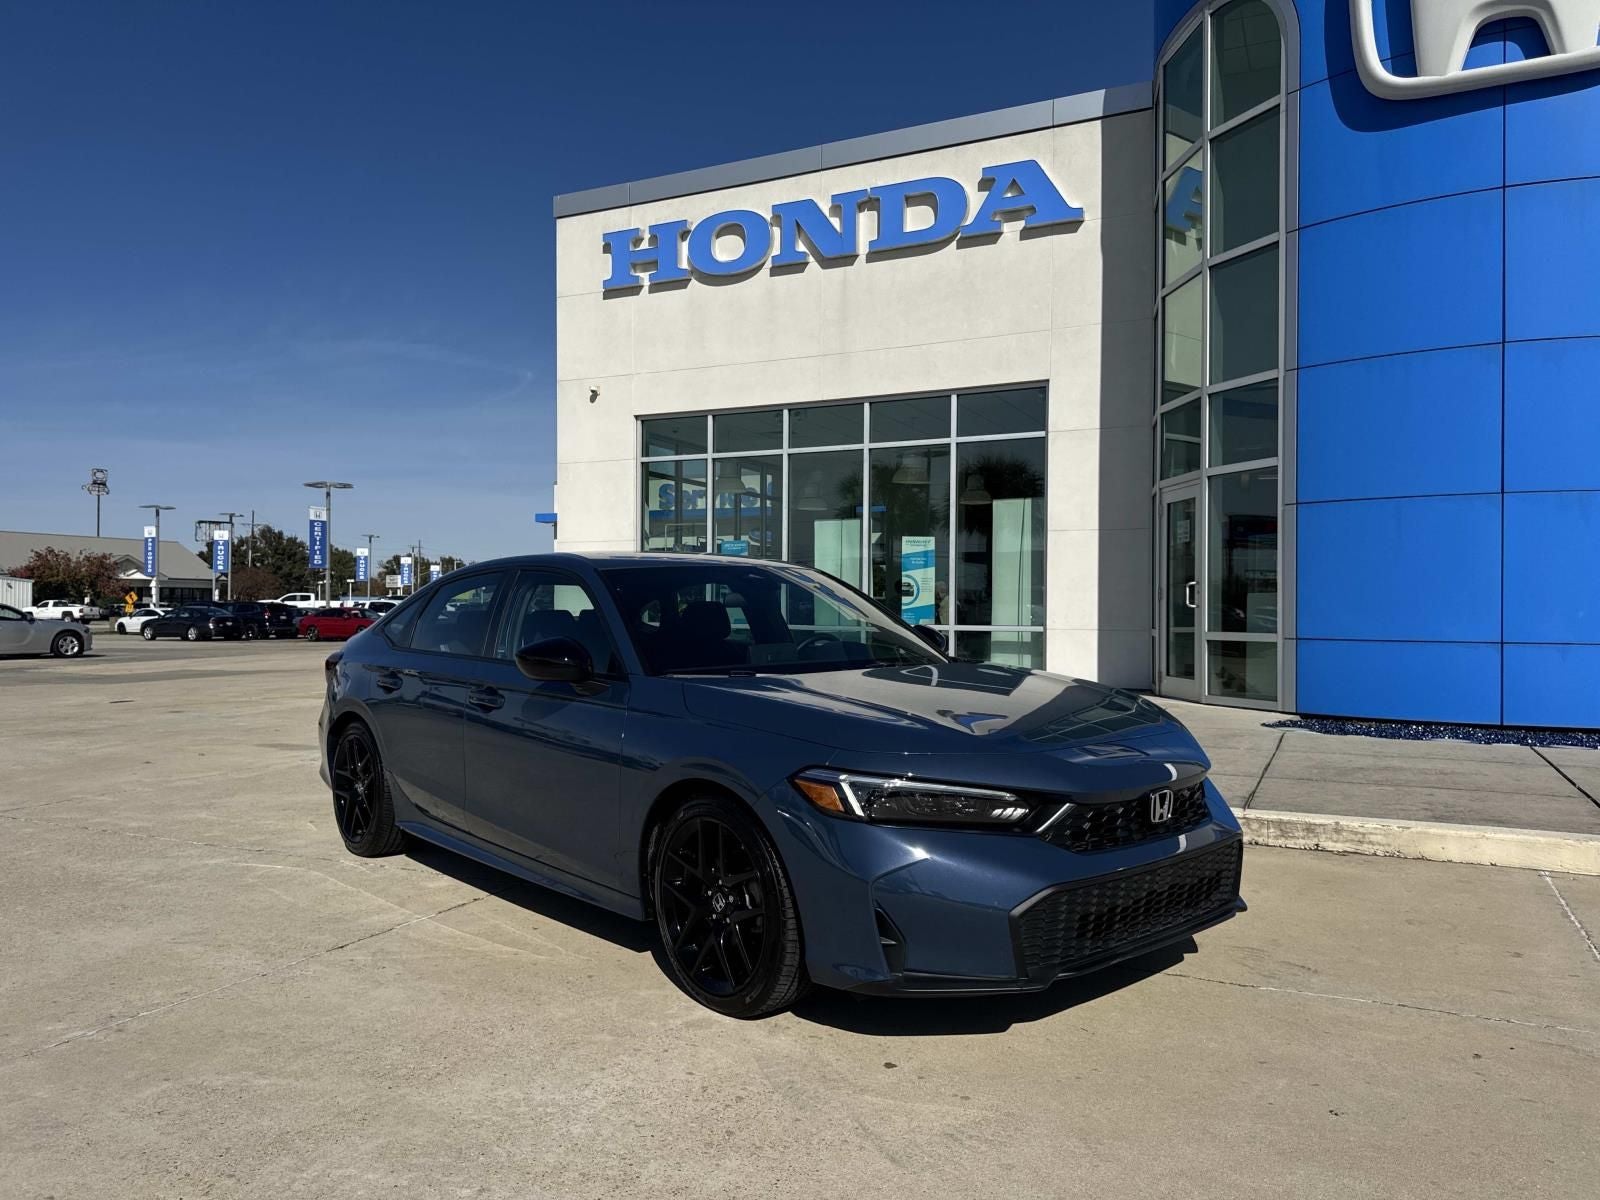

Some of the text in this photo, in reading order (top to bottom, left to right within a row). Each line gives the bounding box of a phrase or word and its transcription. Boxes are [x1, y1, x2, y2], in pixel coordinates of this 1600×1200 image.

[602, 159, 1084, 289] HONDA
[216, 540, 225, 570] TRUCKS
[313, 521, 322, 565] CERTIFIED
